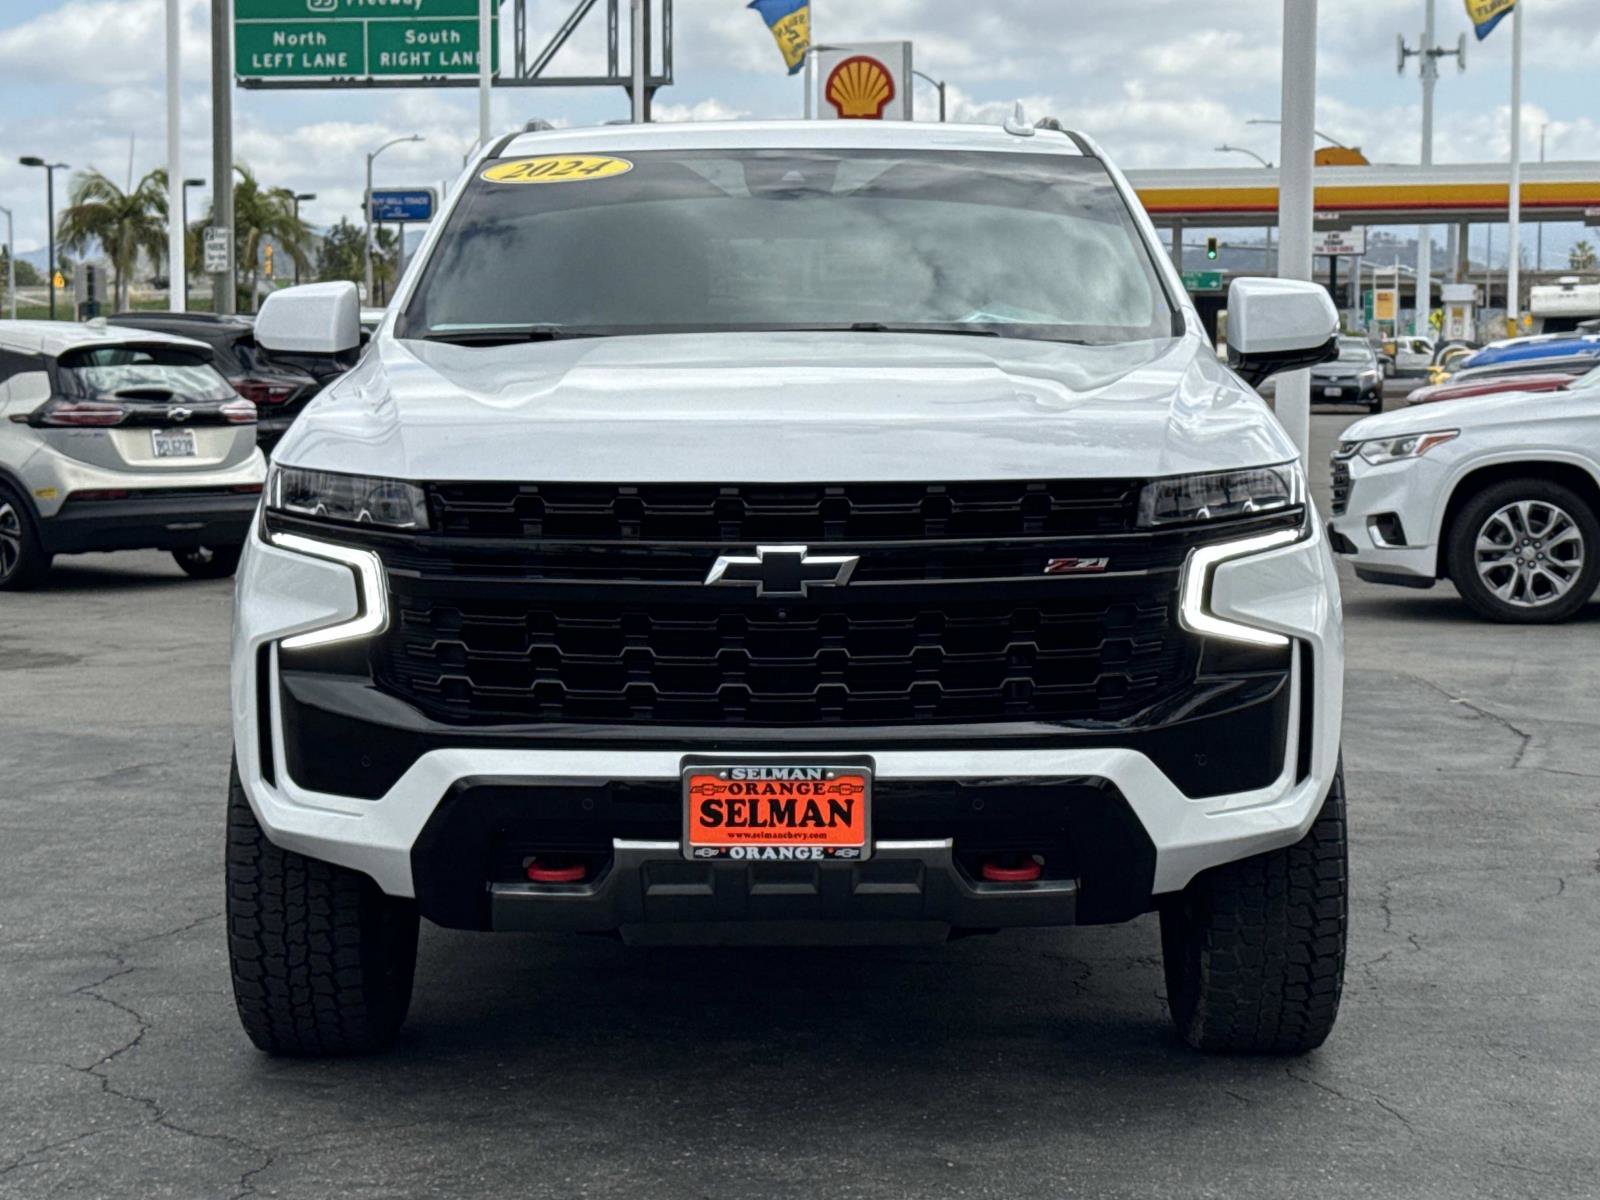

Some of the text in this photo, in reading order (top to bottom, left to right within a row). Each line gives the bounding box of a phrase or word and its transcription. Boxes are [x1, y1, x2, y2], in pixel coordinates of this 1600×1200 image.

[273, 31, 326, 46] North
[405, 29, 460, 44] South
[252, 52, 348, 68] LEFT LANE
[380, 51, 431, 66] RIGHT
[500, 160, 614, 180] 2024
[1044, 557, 1109, 574] Z71
[731, 768, 822, 780] SELMAN
[728, 783, 826, 796] ORANGE
[699, 799, 855, 828] SELMAN
[727, 832, 828, 840] www.selmanchevy.com
[729, 846, 825, 860] ORANGE
